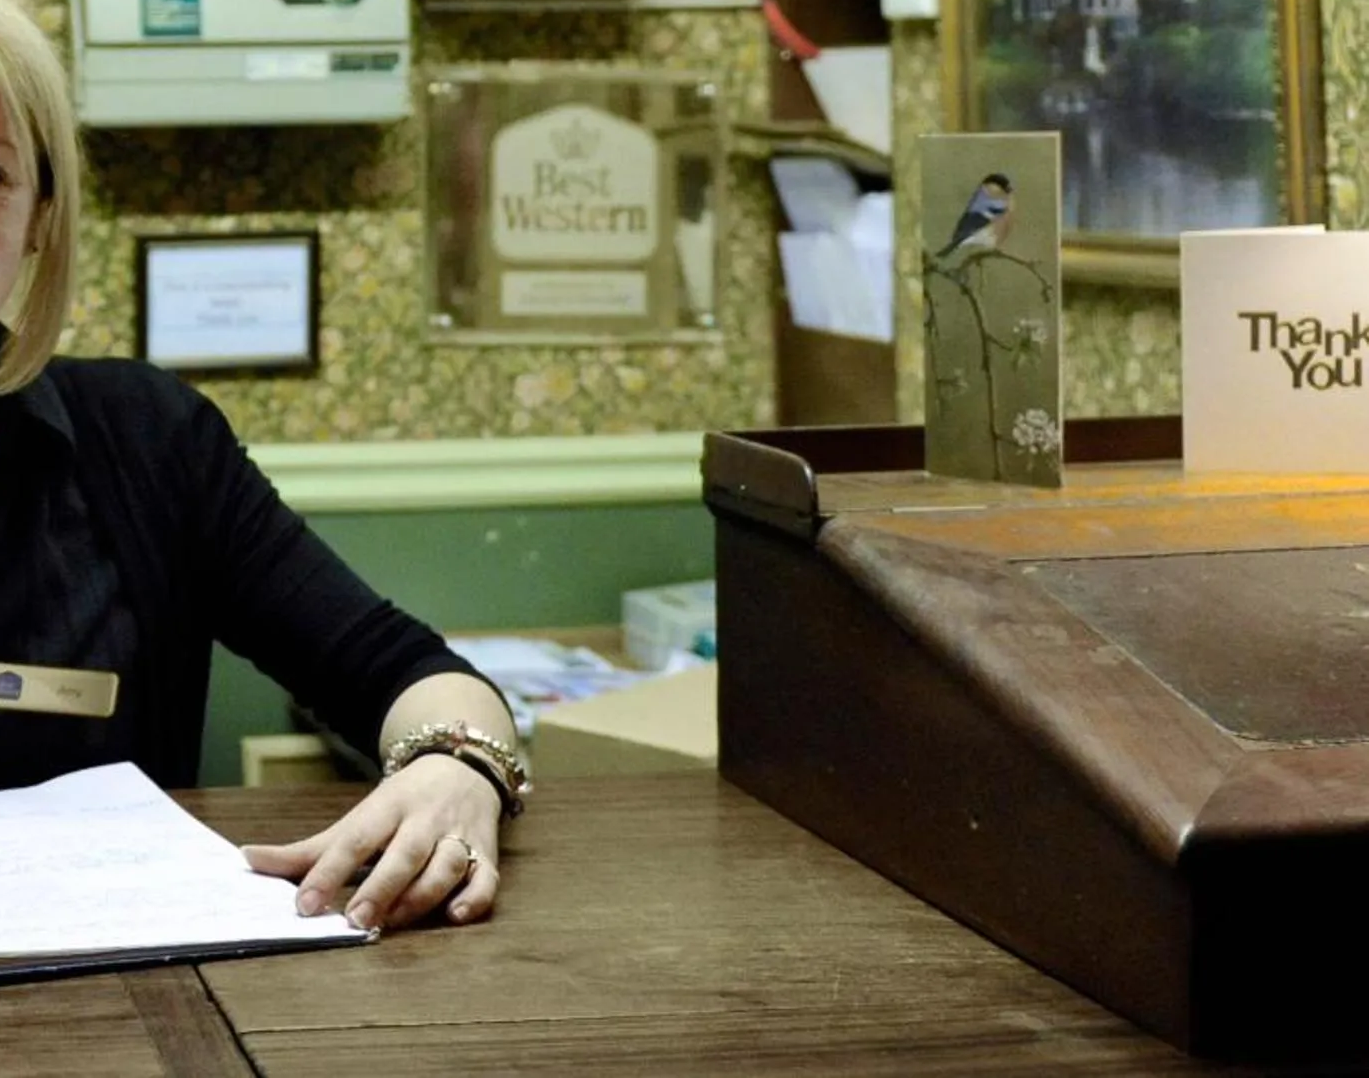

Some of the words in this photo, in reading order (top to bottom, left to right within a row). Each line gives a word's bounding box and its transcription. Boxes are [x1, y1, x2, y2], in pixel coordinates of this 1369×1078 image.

[533, 161, 612, 198] Best
[502, 195, 648, 232] Western
[1238, 311, 1369, 357] Thank
[1279, 349, 1362, 391] You
